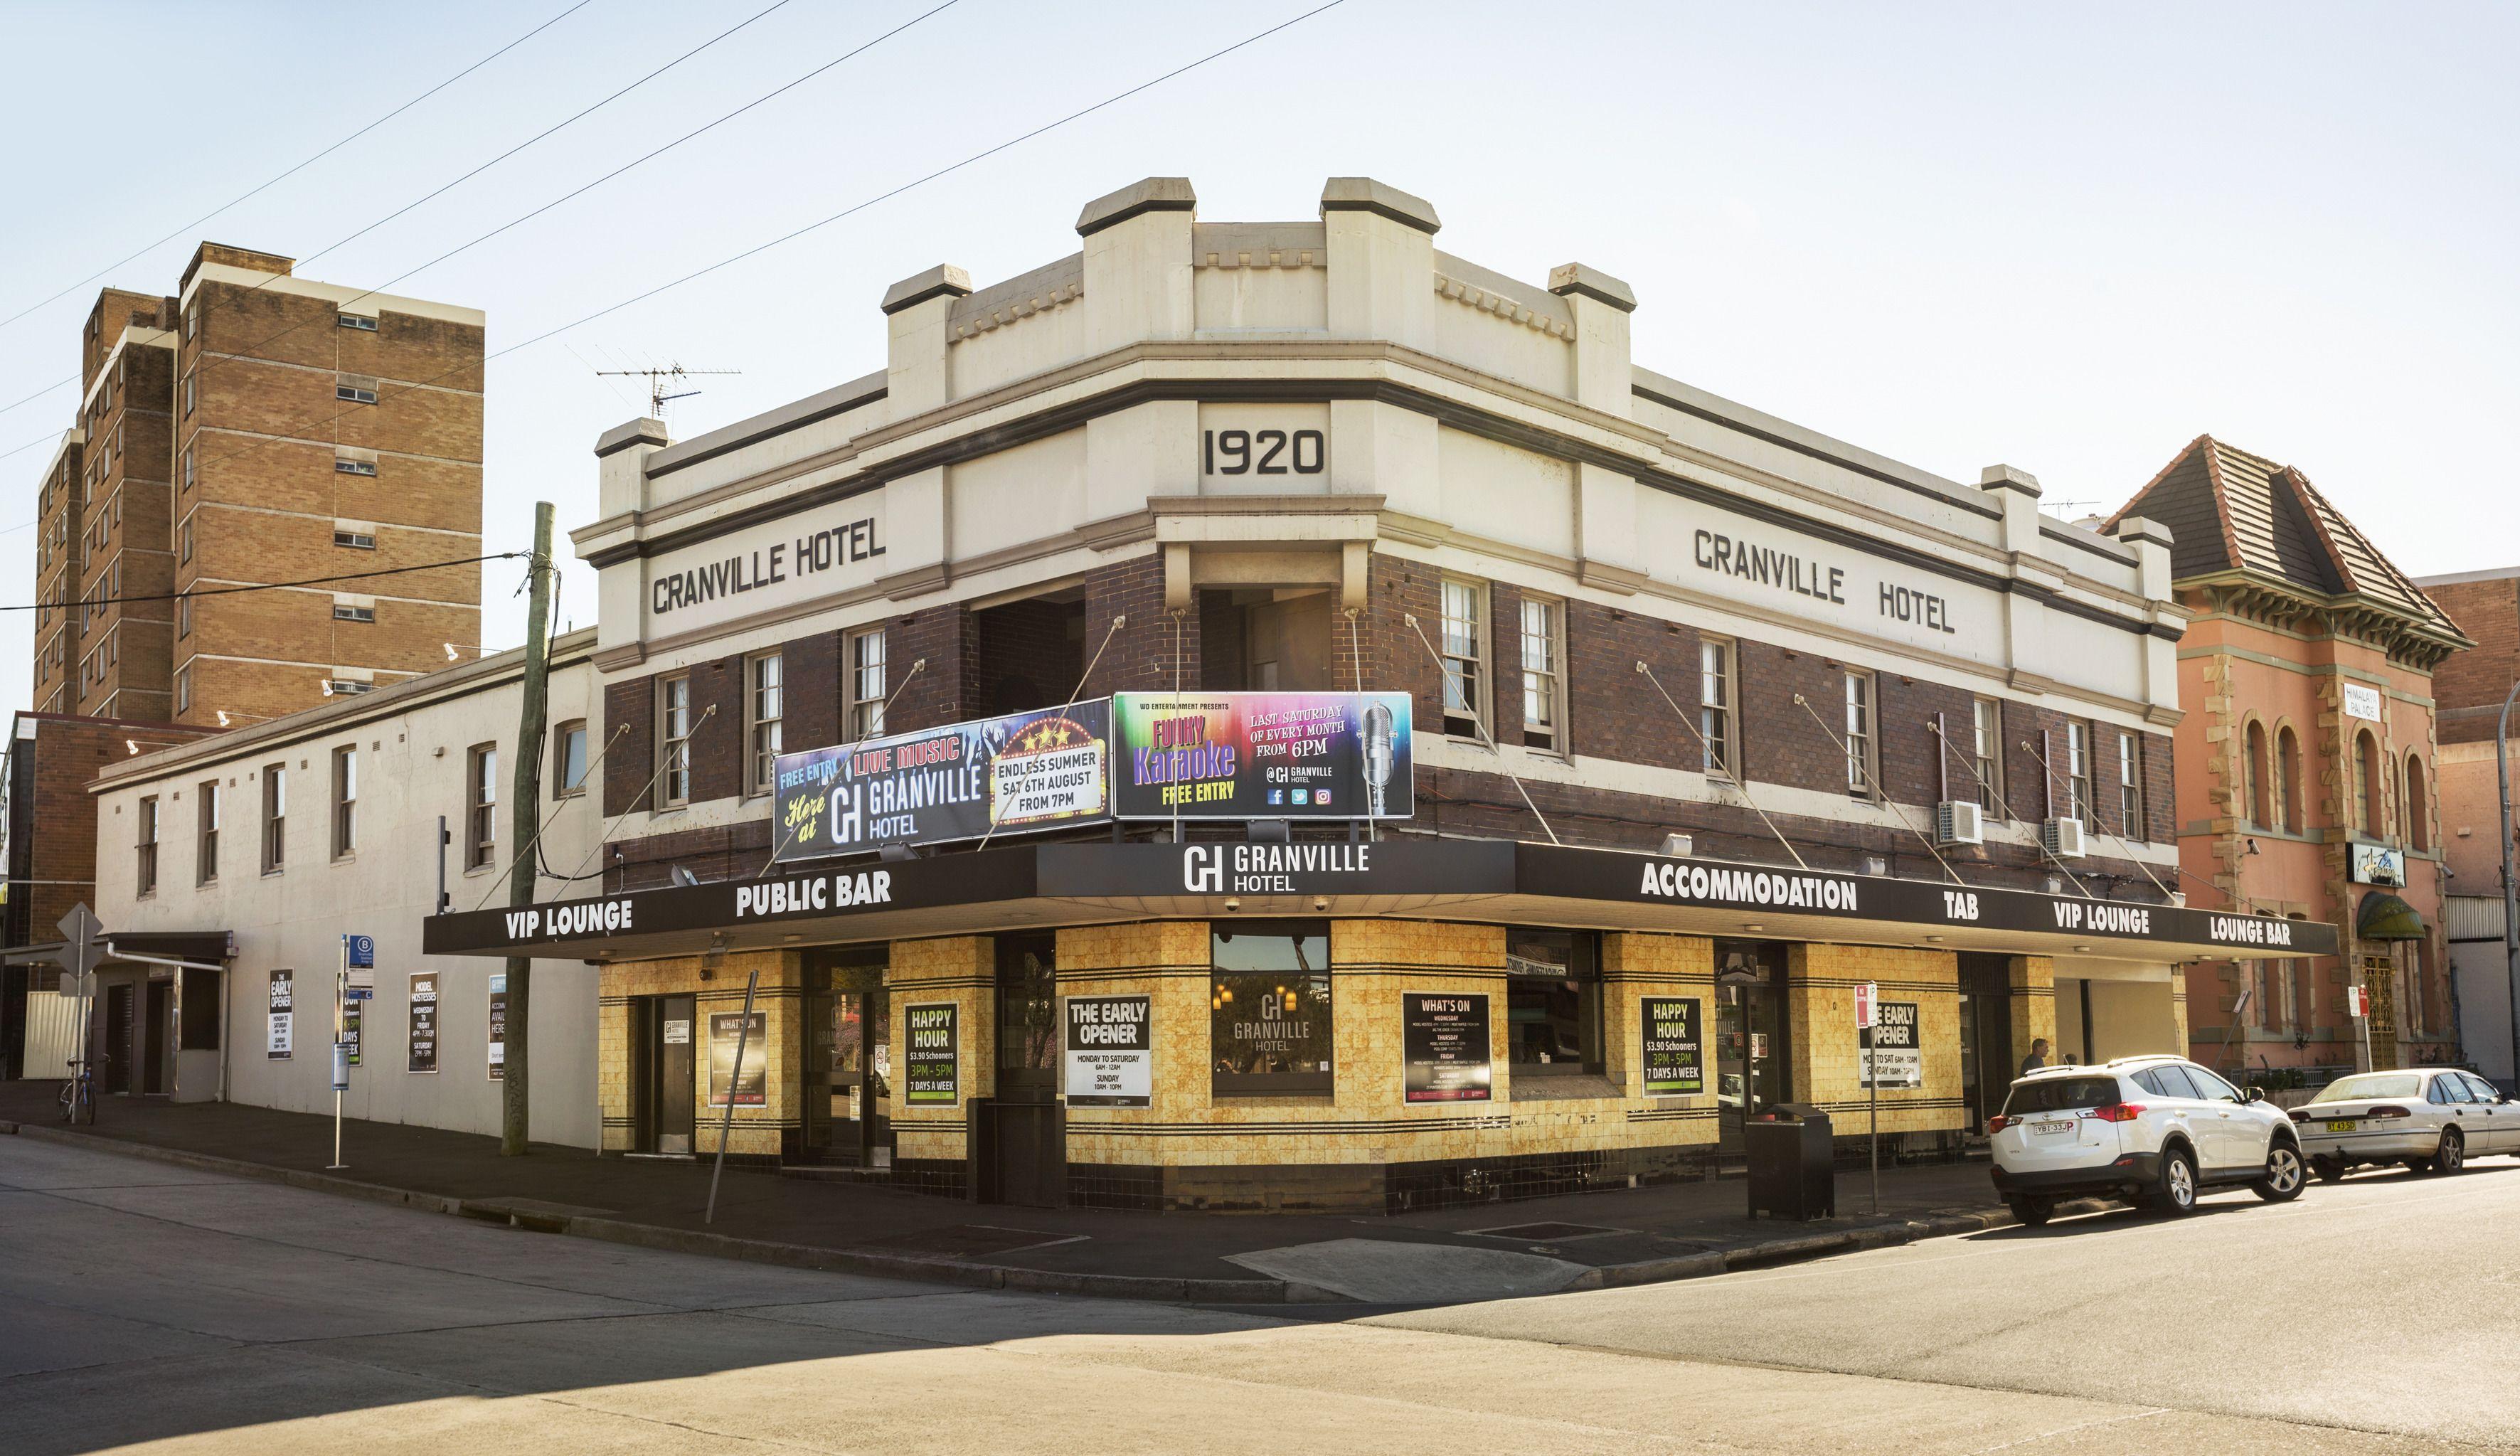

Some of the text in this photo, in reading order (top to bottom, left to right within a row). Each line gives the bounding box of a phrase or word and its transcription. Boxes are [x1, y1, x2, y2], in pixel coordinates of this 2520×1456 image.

[1205, 430, 1324, 474] 1920
[797, 517, 886, 577] HOTEL
[1880, 581, 1955, 634] HOTEL
[2346, 686, 2377, 703] HIMALAYA
[1250, 706, 1344, 728] LAST SATURDAY
[2351, 702, 2374, 718] PALACE
[1153, 716, 1205, 749] FUNKY
[1250, 721, 1345, 743] OF EVERY MONTH
[854, 736, 959, 777] LIVE MUSIC
[1256, 738, 1328, 758] FROM 6PM
[999, 752, 1095, 778] ENDLESS SUMMER
[1133, 740, 1235, 786] Karaoke
[1291, 767, 1332, 777] GRANVILLE
[780, 758, 838, 790] FREE ENTRY
[1003, 771, 1091, 795] SAT 6TH AUGUST
[870, 765, 982, 815] GRANVILLE
[1162, 780, 1235, 805] FREE ENTRY
[785, 794, 825, 827] Here
[1019, 792, 1074, 812] FROM 7PM
[798, 817, 817, 843] at
[870, 814, 918, 839] HOTEL
[1235, 845, 1369, 872] GRANVILLE
[1235, 875, 1296, 891] HOTEL
[1641, 862, 1857, 911] ACCOMMODATION
[737, 870, 891, 917] PUBLIC BAR
[1944, 891, 1979, 920] TAB
[506, 900, 632, 939] VIP LOUNGE
[2053, 901, 2149, 934] VIP LOUNGE
[2210, 917, 2291, 946] LOUNGE BAR
[361, 940, 368, 950] B
[271, 980, 292, 996] EARLY
[415, 982, 432, 992] MODEL
[271, 996, 291, 1007] OPENER
[411, 992, 437, 1002] HOSTESSES
[1422, 999, 1470, 1011] WHAT'S ON
[491, 1011, 505, 1021] AVAIL
[912, 1010, 952, 1028] HAPPY
[1070, 1003, 1147, 1023] THE EARLY
[1654, 1004, 1688, 1019] HAPPY
[1885, 1006, 1914, 1025] EARLY
[344, 1031, 357, 1043] DAYS
[491, 1024, 504, 1033] HERE
[1080, 1024, 1137, 1044] OPENER
[1234, 1021, 1309, 1039] GRANVILLE
[1657, 1022, 1686, 1038] HOUR
[915, 1031, 948, 1048] HOUR
[1255, 1041, 1290, 1051] HOTEL
[1647, 1041, 1696, 1052] $3.90 Schooners
[910, 1052, 925, 1061] $3.90
[1653, 1053, 1691, 1065] 3PM 5PM
[1876, 1055, 1883, 1063] TO
[1885, 1055, 1893, 1063] SAT
[911, 1064, 952, 1076] 3PM 5PM
[1647, 1067, 1698, 1079] 7 DAYS A WEEK
[1868, 1067, 1888, 1075] SNDAY
[910, 1081, 954, 1090] 7 DAYS A WEEK
[2067, 1122, 2073, 1131] P
